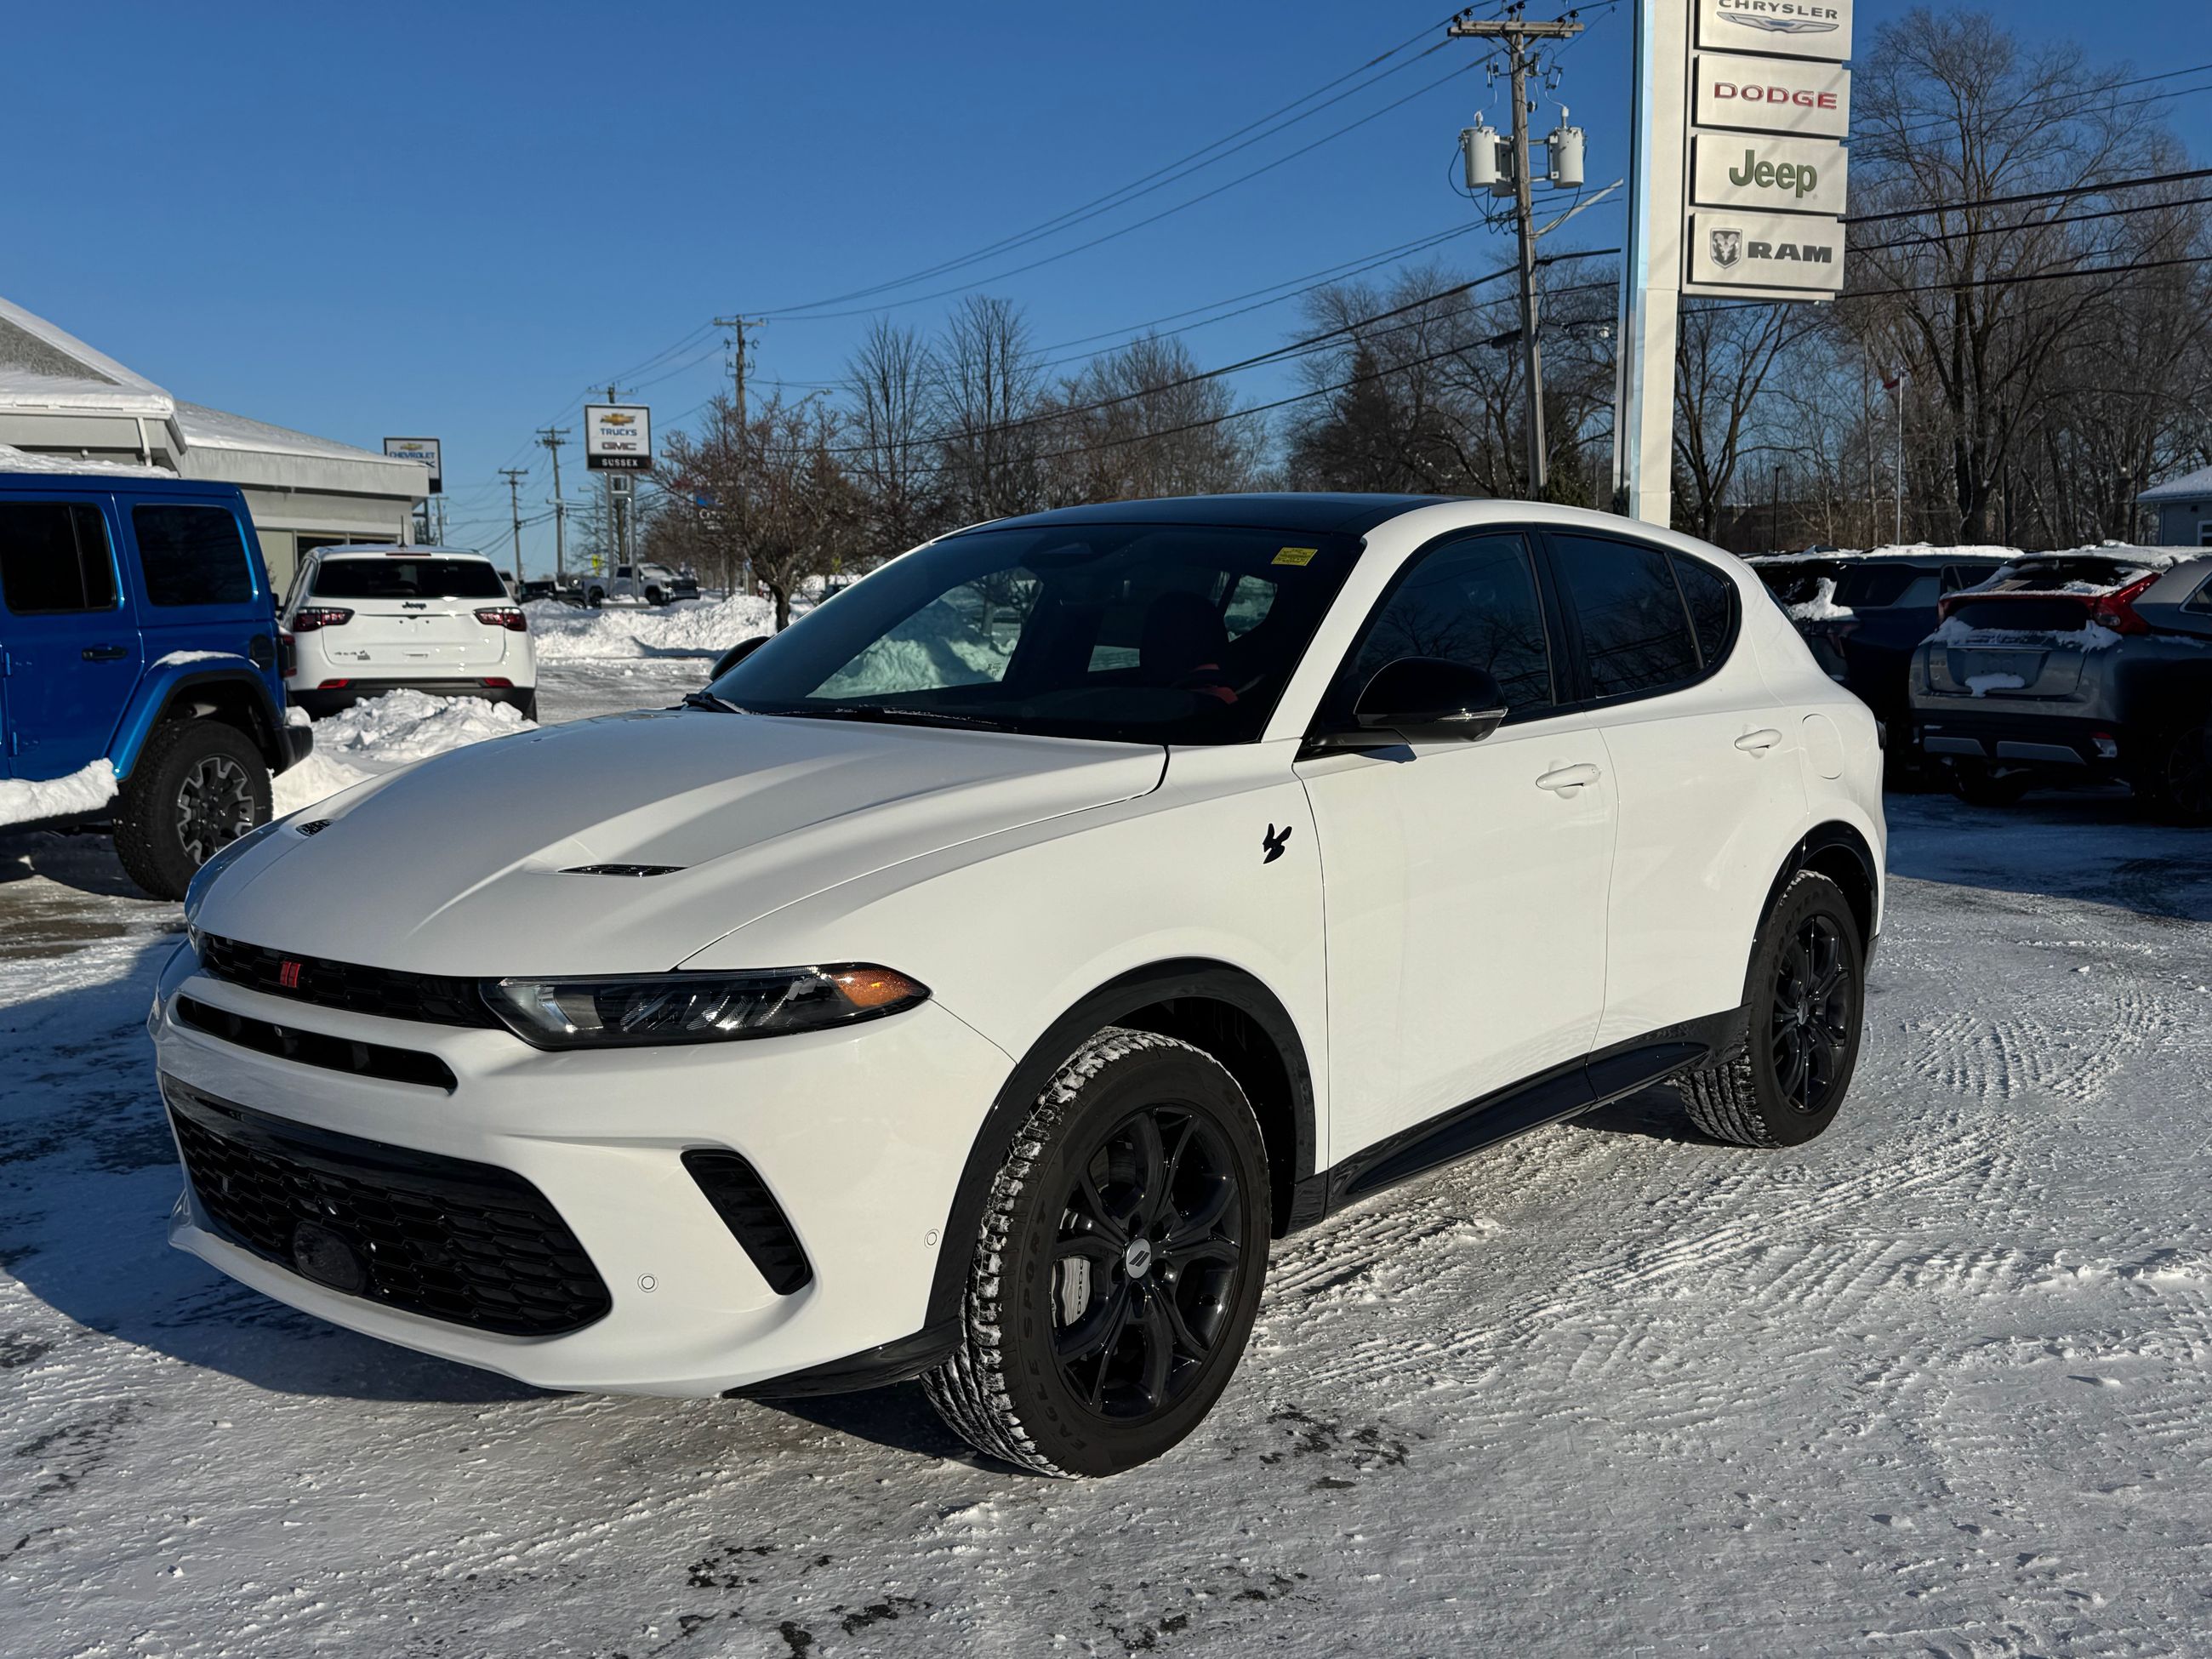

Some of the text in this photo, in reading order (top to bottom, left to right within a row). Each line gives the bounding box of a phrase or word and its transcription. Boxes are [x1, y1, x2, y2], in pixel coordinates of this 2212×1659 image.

[1719, 0, 1838, 19] CHRYSLER
[1714, 82, 1838, 110] DODGE
[1729, 149, 1817, 198] Jeep
[1747, 242, 1832, 264] RAM
[602, 442, 636, 450] GMC
[601, 459, 638, 467] SUSSEX
[1023, 1200, 1086, 1450] EAGLE SPORT
